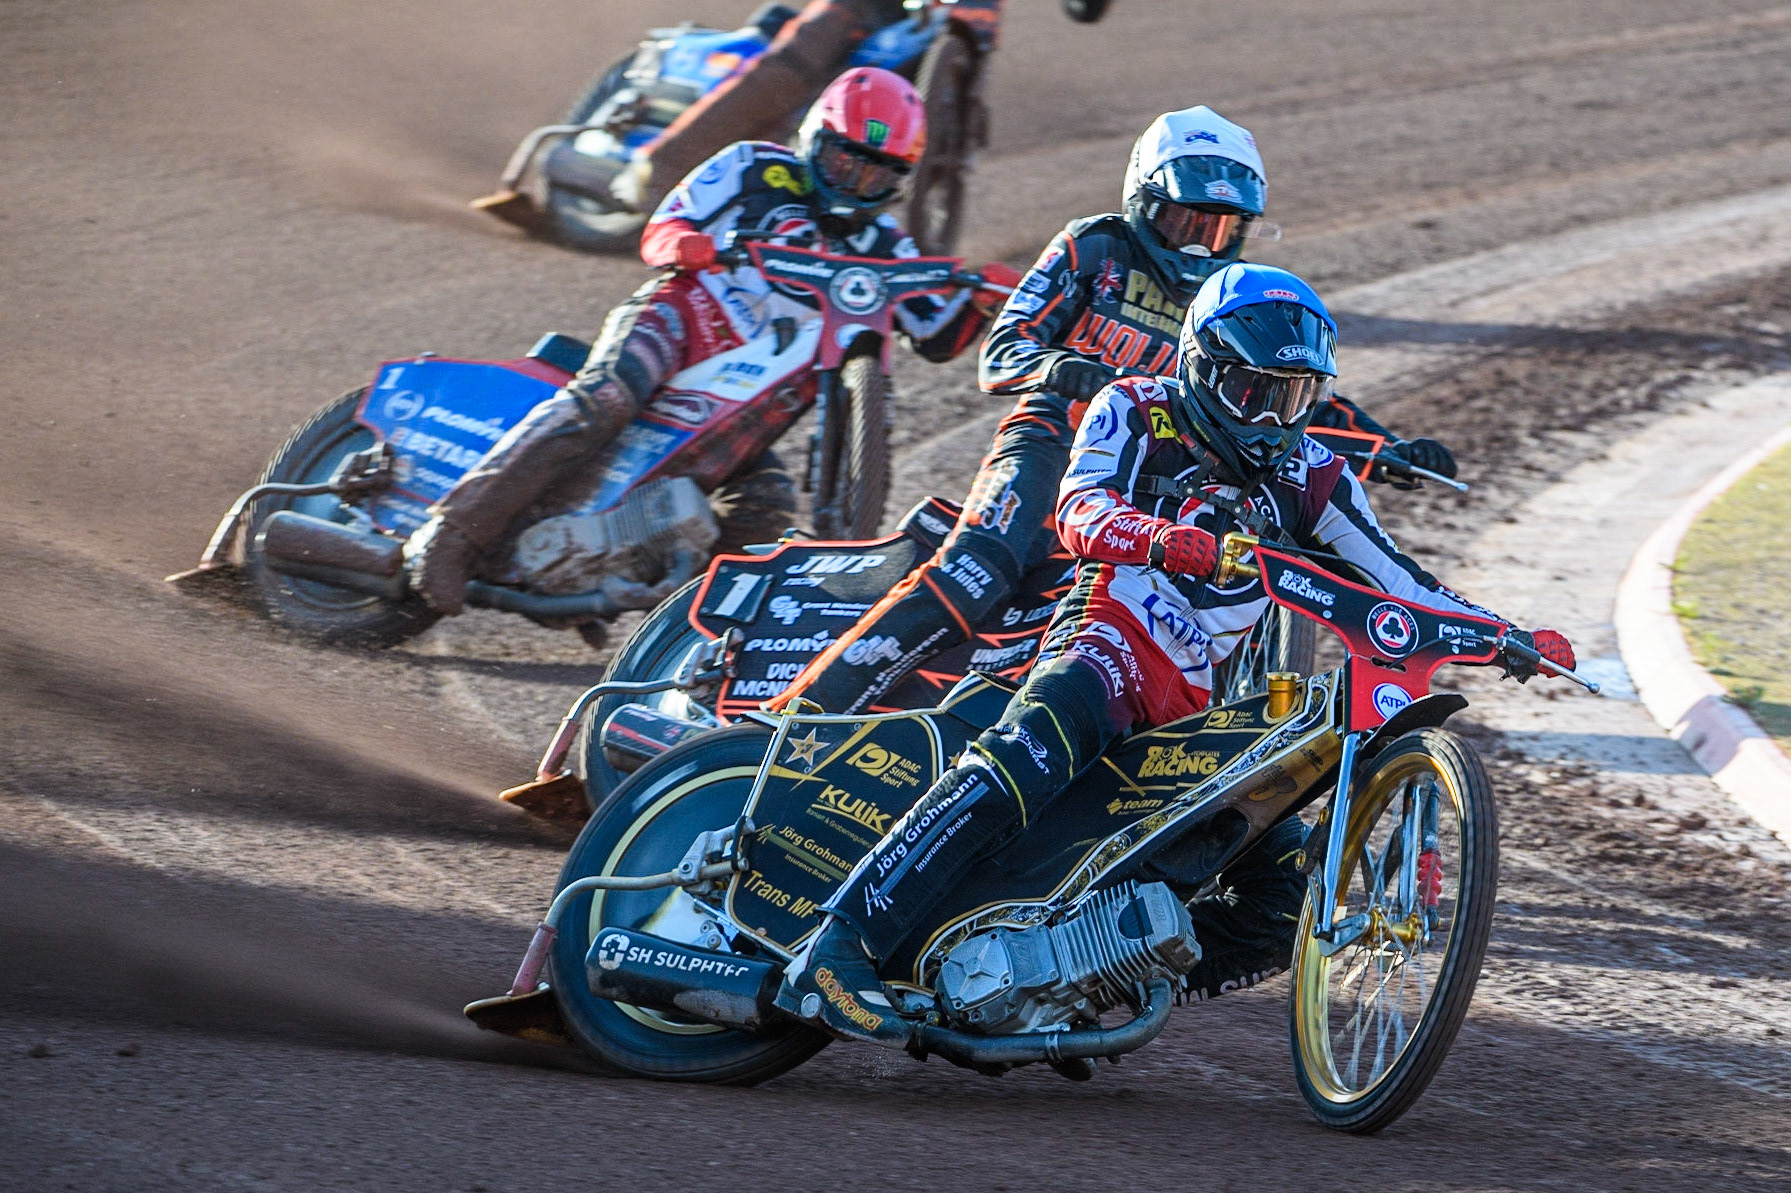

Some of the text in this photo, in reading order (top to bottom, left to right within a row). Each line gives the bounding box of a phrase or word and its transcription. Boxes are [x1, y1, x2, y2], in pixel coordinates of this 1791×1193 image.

[1282, 348, 1320, 363] SHOEI
[377, 367, 405, 389] 1
[1103, 529, 1136, 551] Sport
[785, 555, 887, 575] JWP
[955, 553, 993, 585] Harry
[713, 572, 762, 616] 1
[950, 566, 986, 600] Jules
[1278, 575, 1334, 606] RACING
[889, 766, 920, 787] Stiftung
[898, 758, 921, 773] ADAC
[1137, 756, 1219, 778] RACING
[880, 773, 903, 788] Sport
[1123, 799, 1163, 809] team
[876, 773, 978, 877] Jörg Grohmann
[778, 826, 804, 846] Jörg
[803, 838, 854, 873] Grohman
[914, 811, 973, 873] Insurance Broker
[784, 853, 832, 883] Insurance Broker
[743, 869, 791, 907] Trans
[627, 947, 653, 964] SH
[815, 967, 884, 1031] daytona
